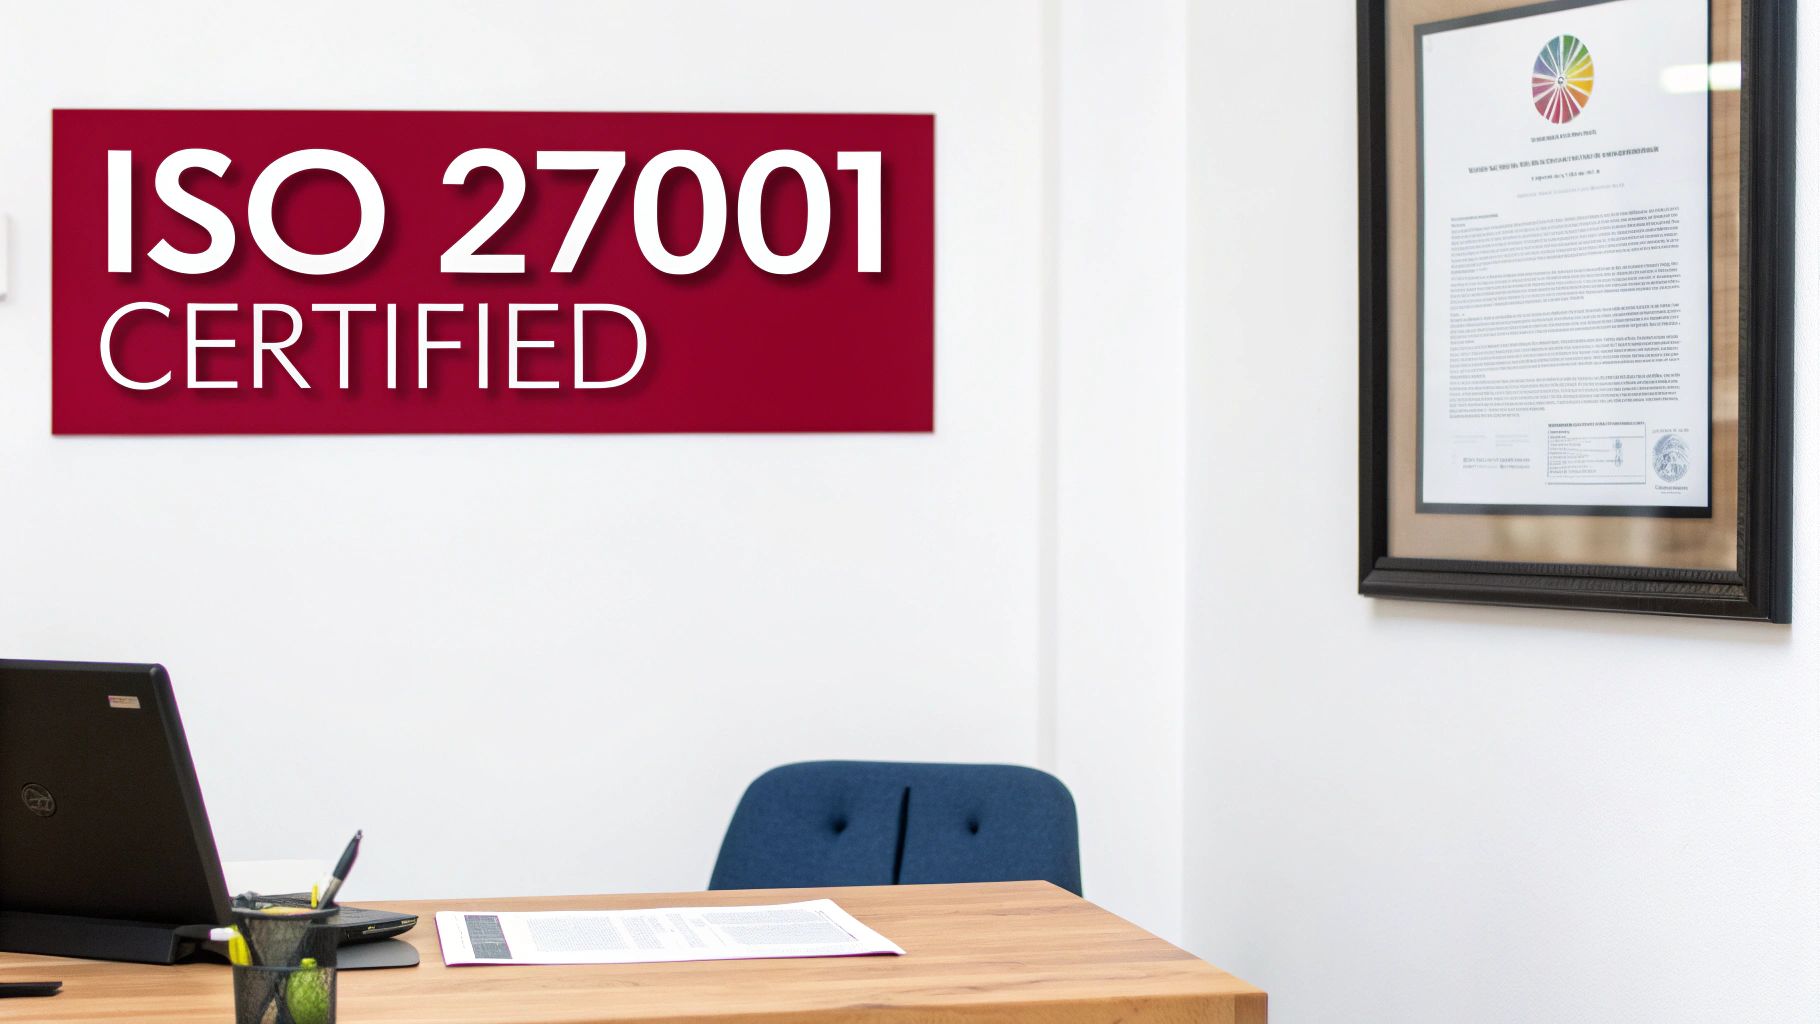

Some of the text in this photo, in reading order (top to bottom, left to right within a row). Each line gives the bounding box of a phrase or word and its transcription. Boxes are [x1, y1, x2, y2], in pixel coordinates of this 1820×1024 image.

[107, 147, 882, 275] ISO 27001
[99, 301, 648, 391] CERTIFIED
